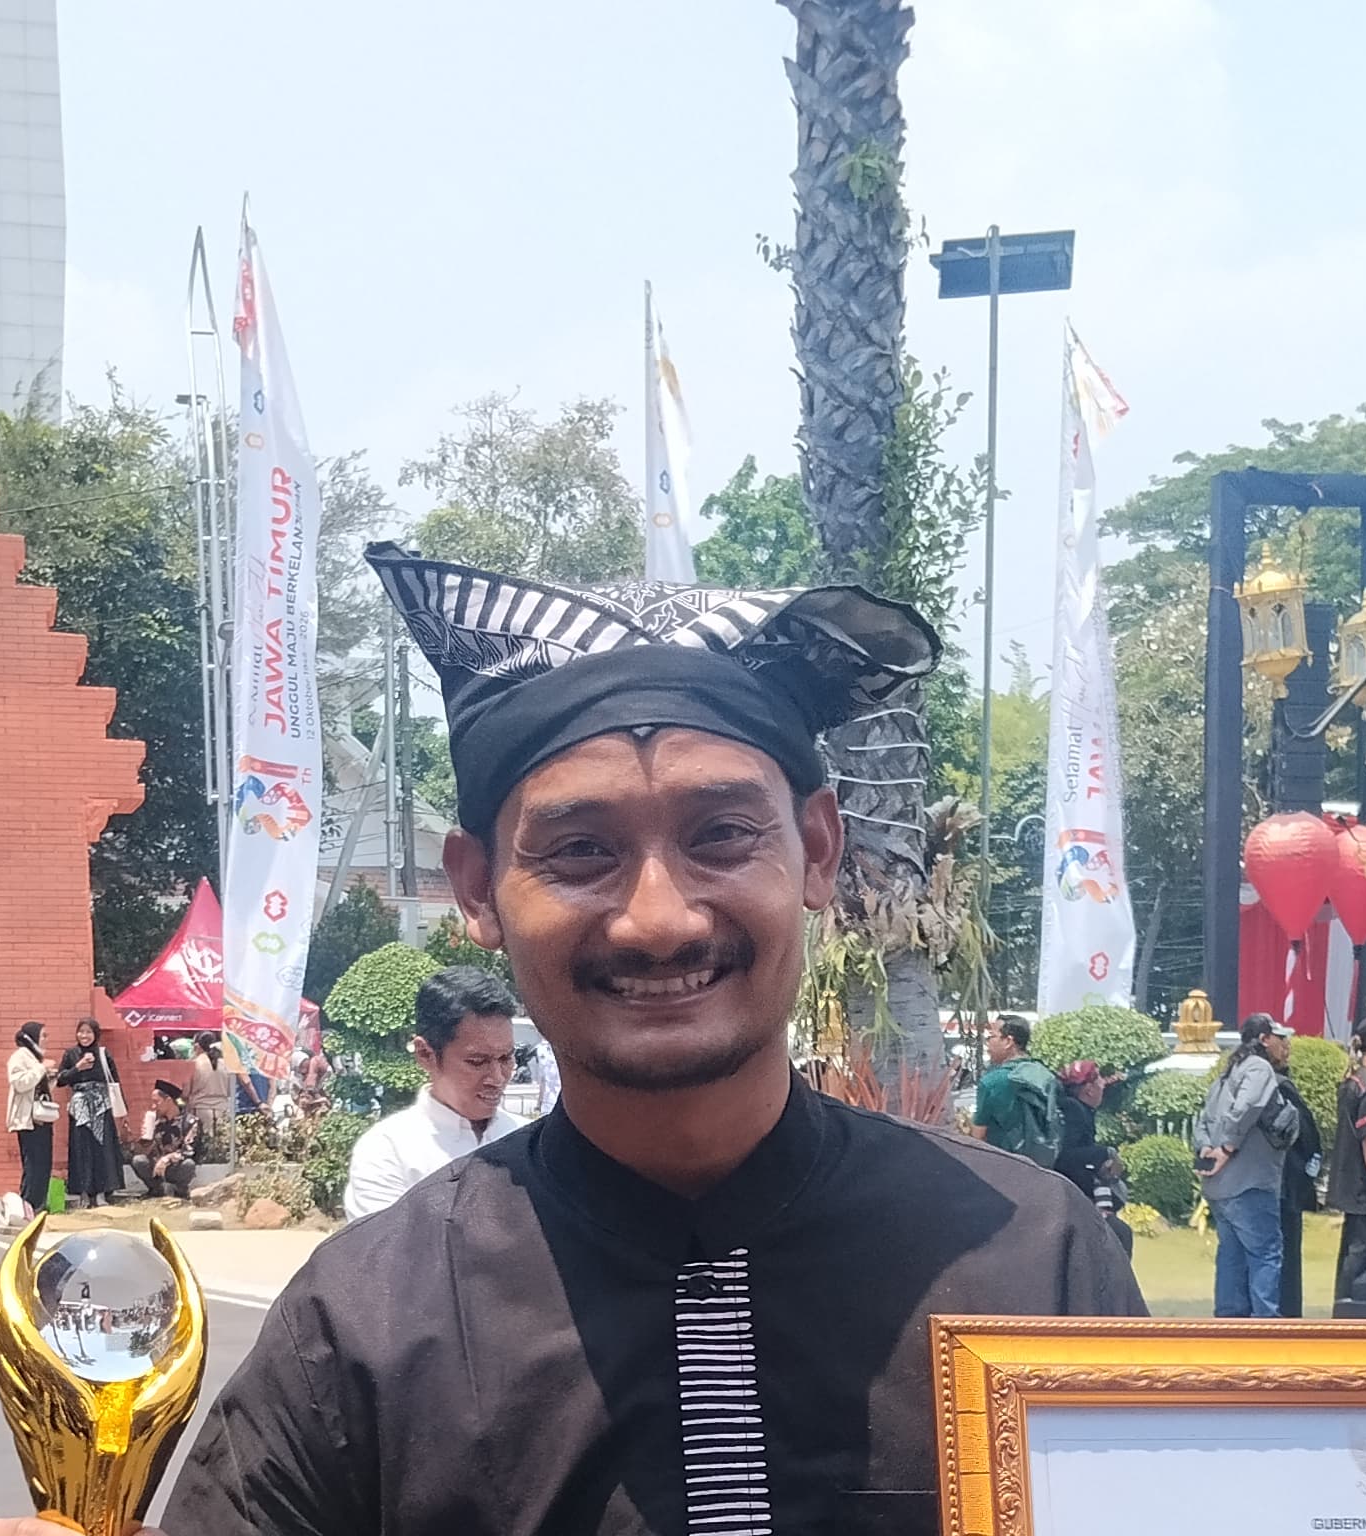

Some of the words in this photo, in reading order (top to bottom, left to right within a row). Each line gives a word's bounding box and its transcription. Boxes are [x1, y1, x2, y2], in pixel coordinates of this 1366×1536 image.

[267, 467, 292, 600] TIMUR
[264, 618, 286, 735] JAWA
[287, 622, 298, 667] MAJU
[287, 672, 301, 739] UNGGUL
[1064, 725, 1084, 803] Selamat
